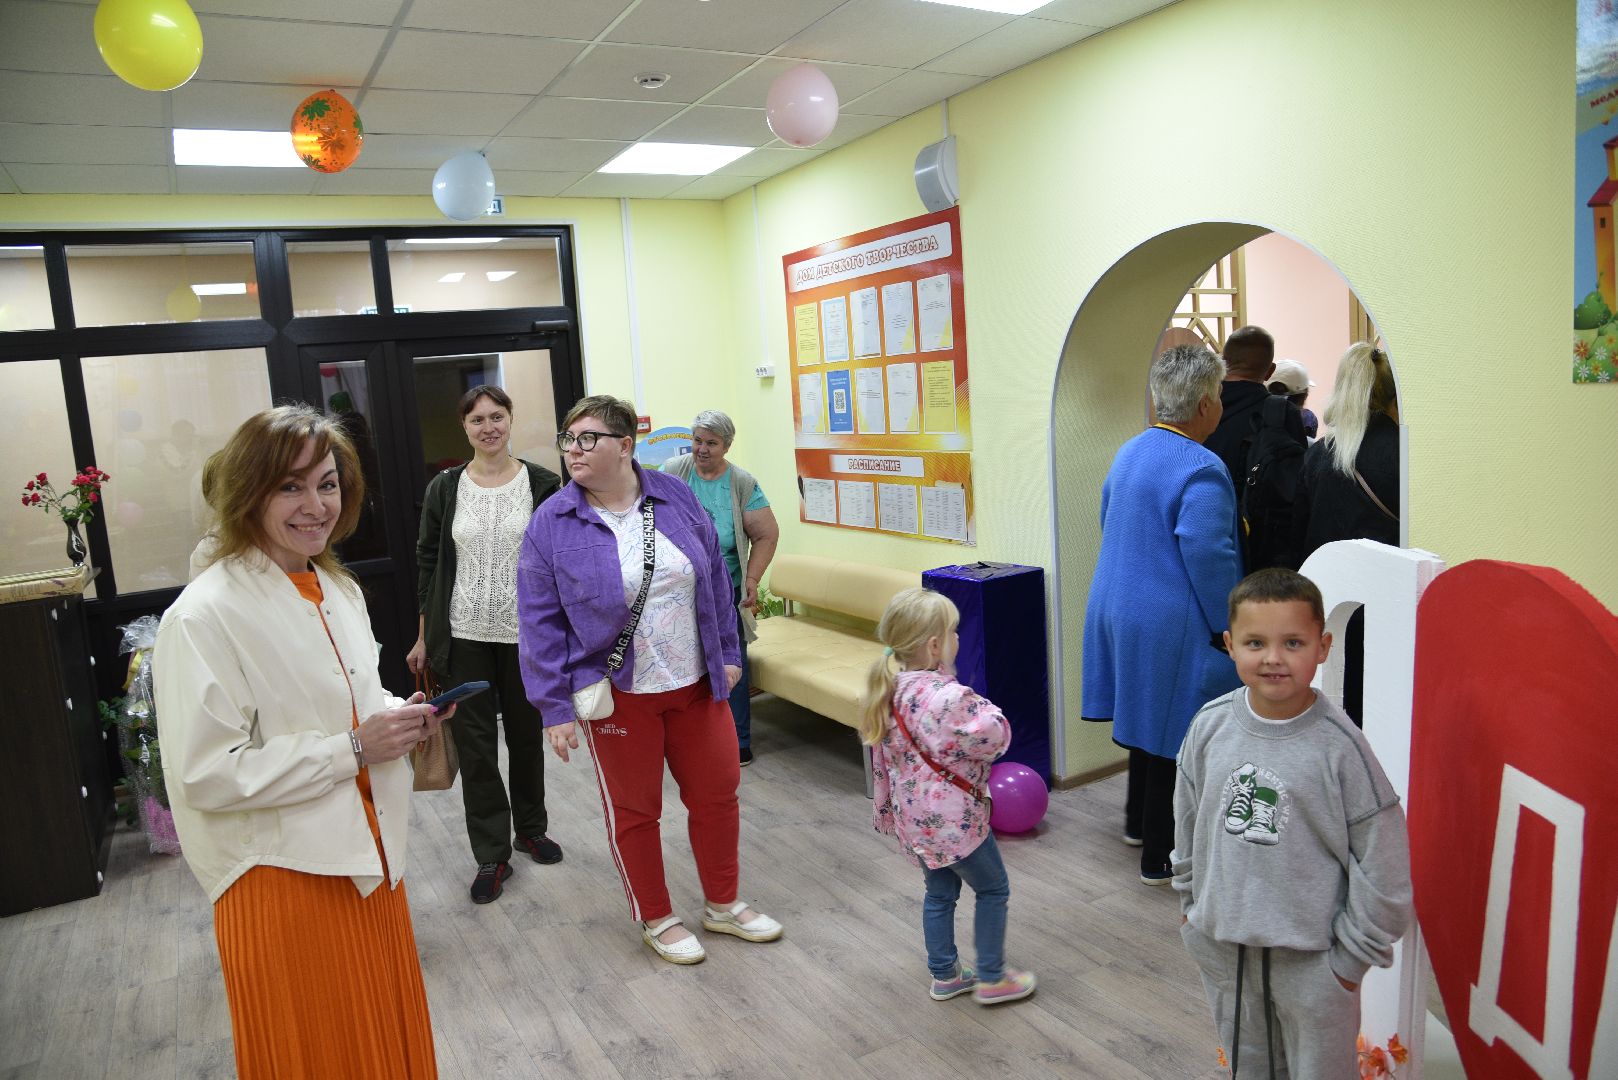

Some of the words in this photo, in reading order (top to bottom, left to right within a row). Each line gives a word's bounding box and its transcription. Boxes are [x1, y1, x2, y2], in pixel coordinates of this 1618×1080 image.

[796, 266, 815, 286] ДОМ
[816, 254, 865, 281] ДЕТСКОГО
[865, 235, 939, 266] ТВОРЧЕСТВА
[848, 458, 901, 472] РАСПИСАНИЕ
